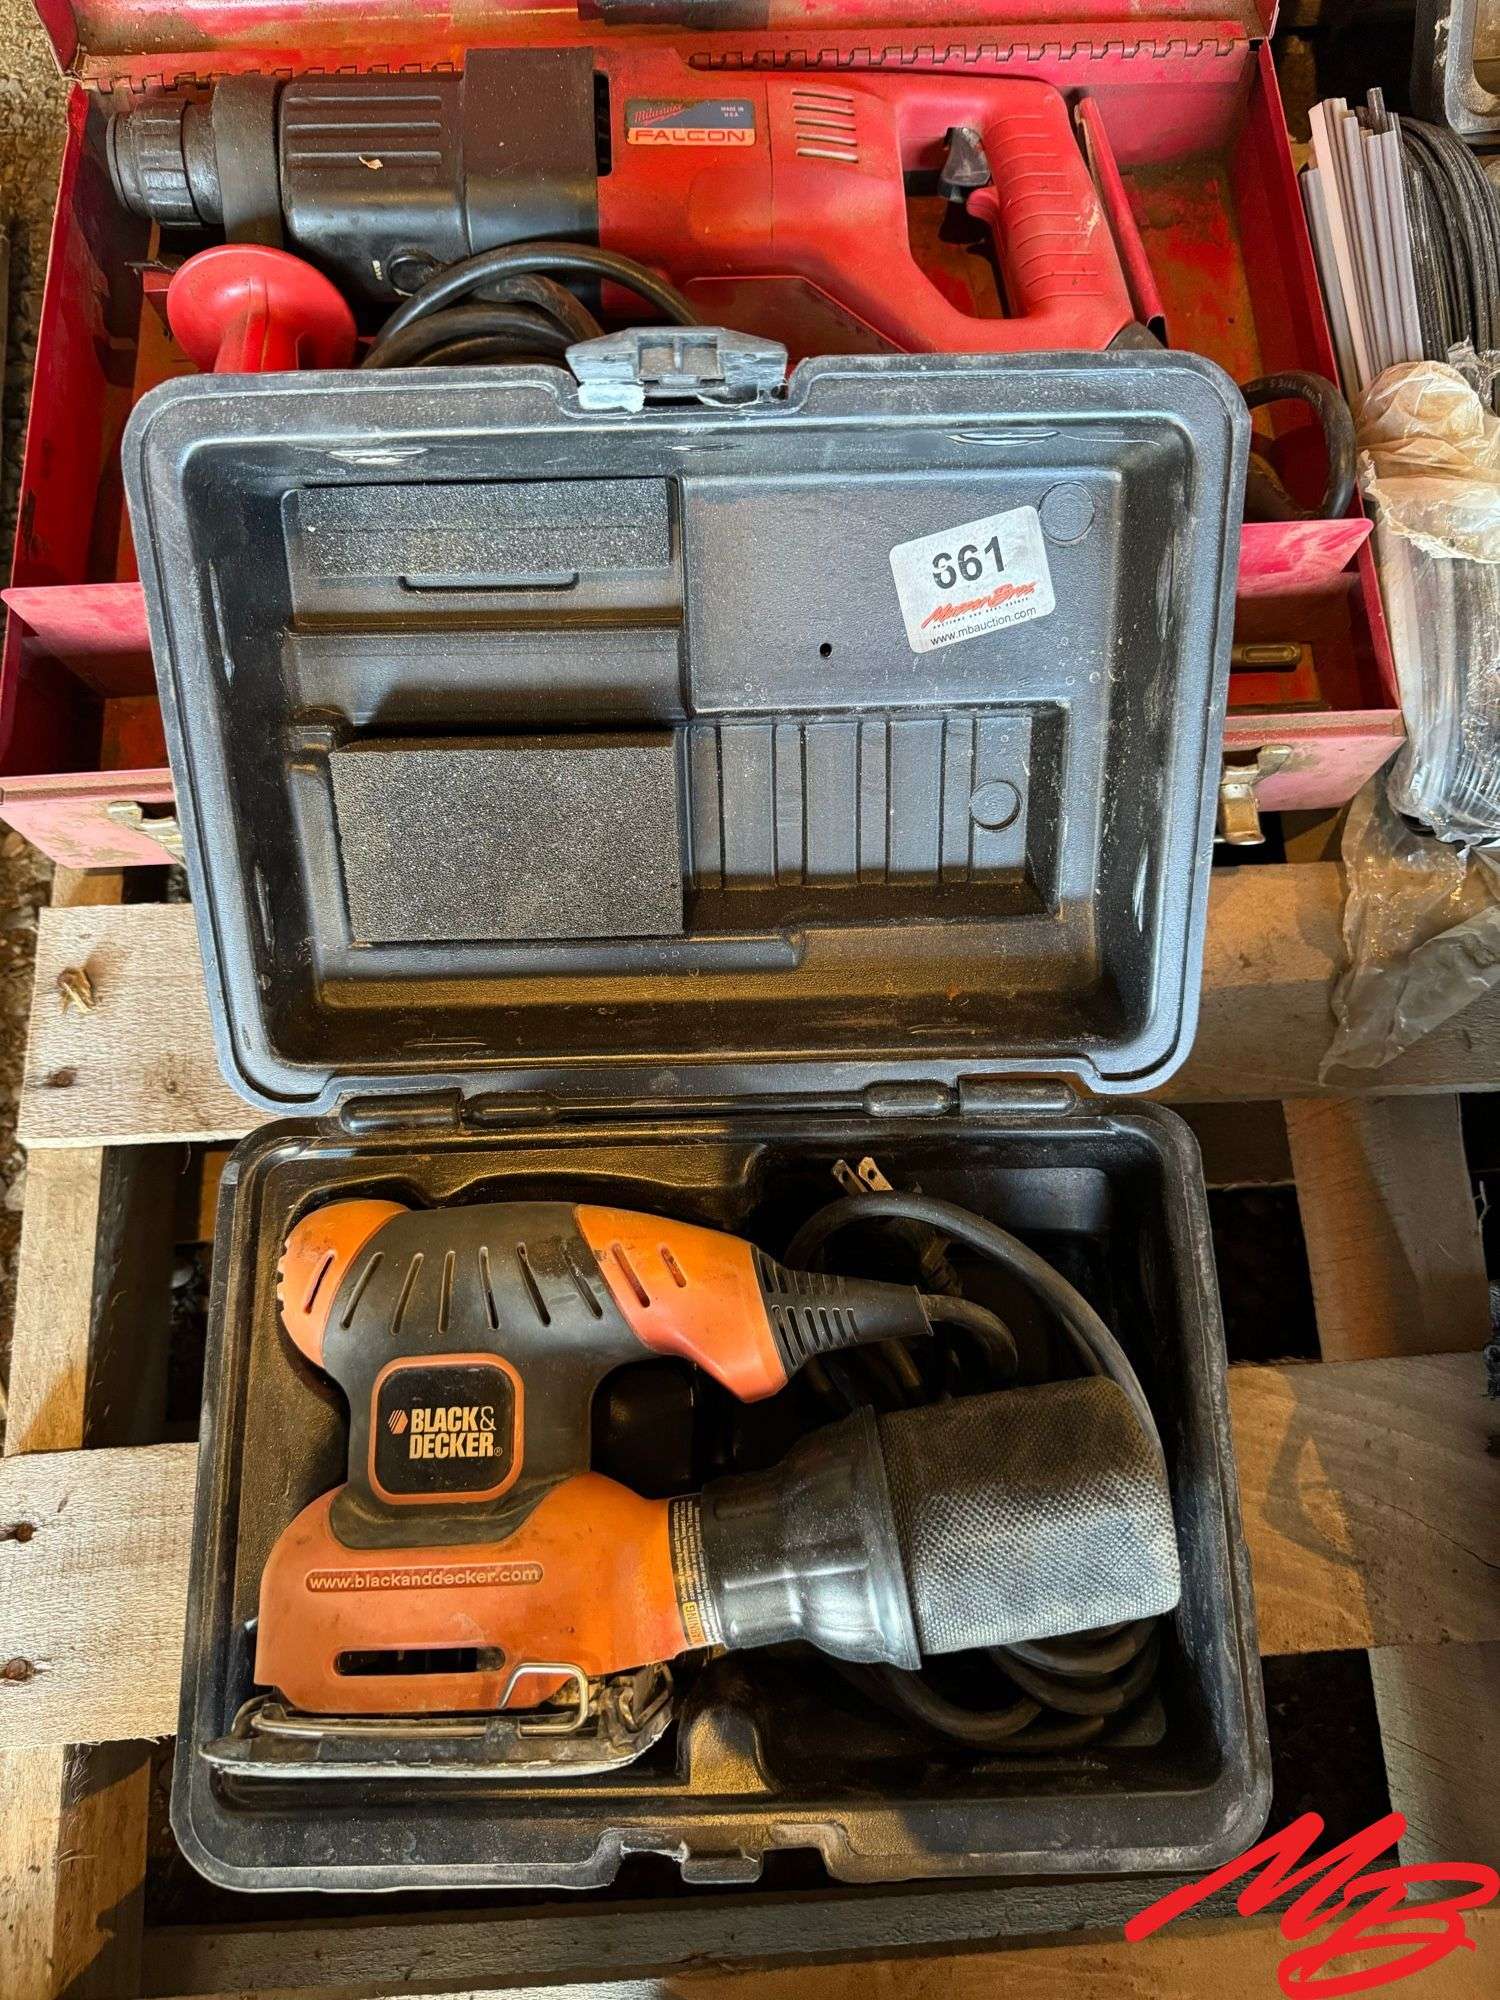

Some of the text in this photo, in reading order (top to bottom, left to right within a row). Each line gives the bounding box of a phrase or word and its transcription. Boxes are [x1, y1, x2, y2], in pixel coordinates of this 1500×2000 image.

[635, 130, 746, 142] FALCON
[932, 535, 1005, 590] 661
[929, 606, 1037, 646] www.mbauction.com
[309, 1567, 540, 1590] www.blackanddecker.com
